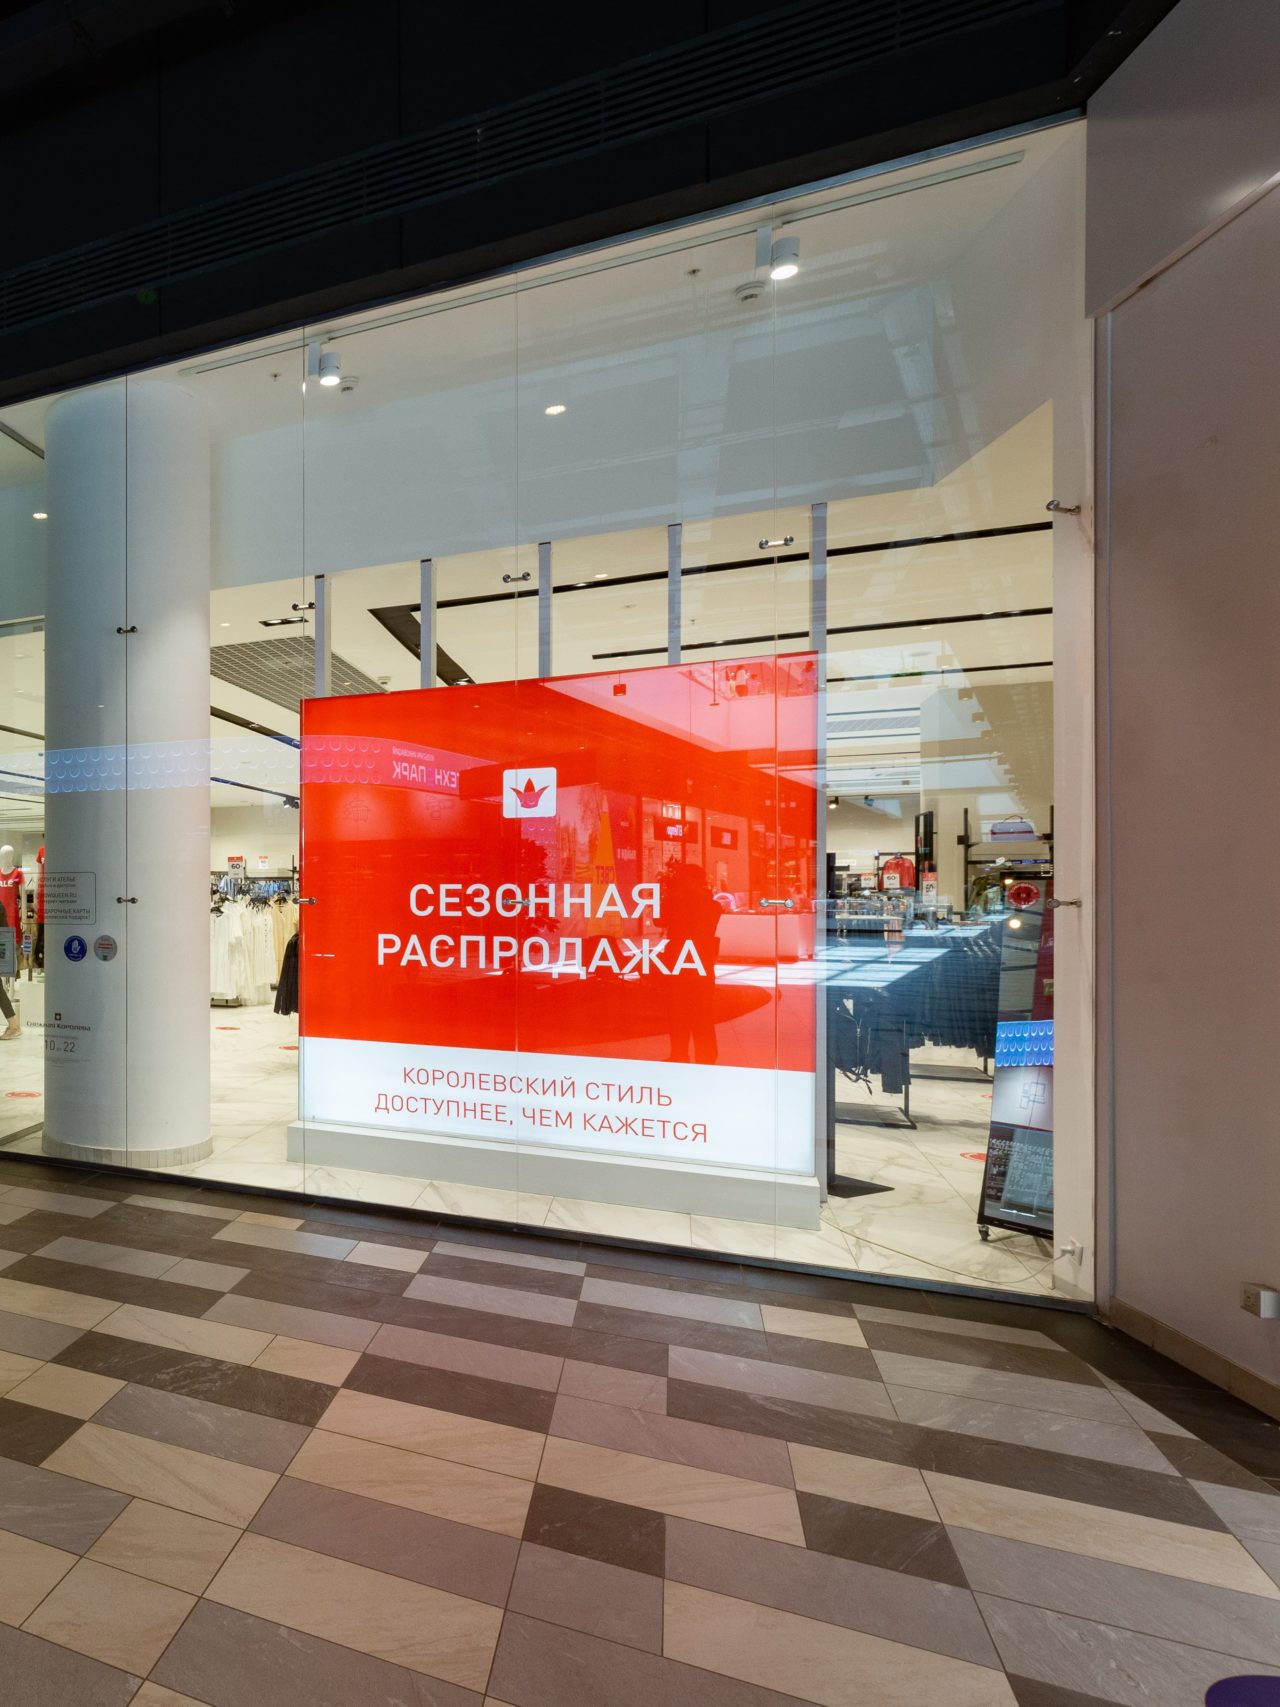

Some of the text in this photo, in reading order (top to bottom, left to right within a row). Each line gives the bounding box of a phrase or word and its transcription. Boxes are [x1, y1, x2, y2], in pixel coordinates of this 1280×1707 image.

[409, 883, 661, 919] СЕЗОННАЯ
[377, 933, 707, 980] РАСПРОДАЖА
[402, 1066, 673, 1108] КОРОЛЕВСКИЙ СТИЛЬ
[374, 1093, 708, 1144] ДОСТУПНЕЕ, ЧЕМ КАЖЕТСЯ
